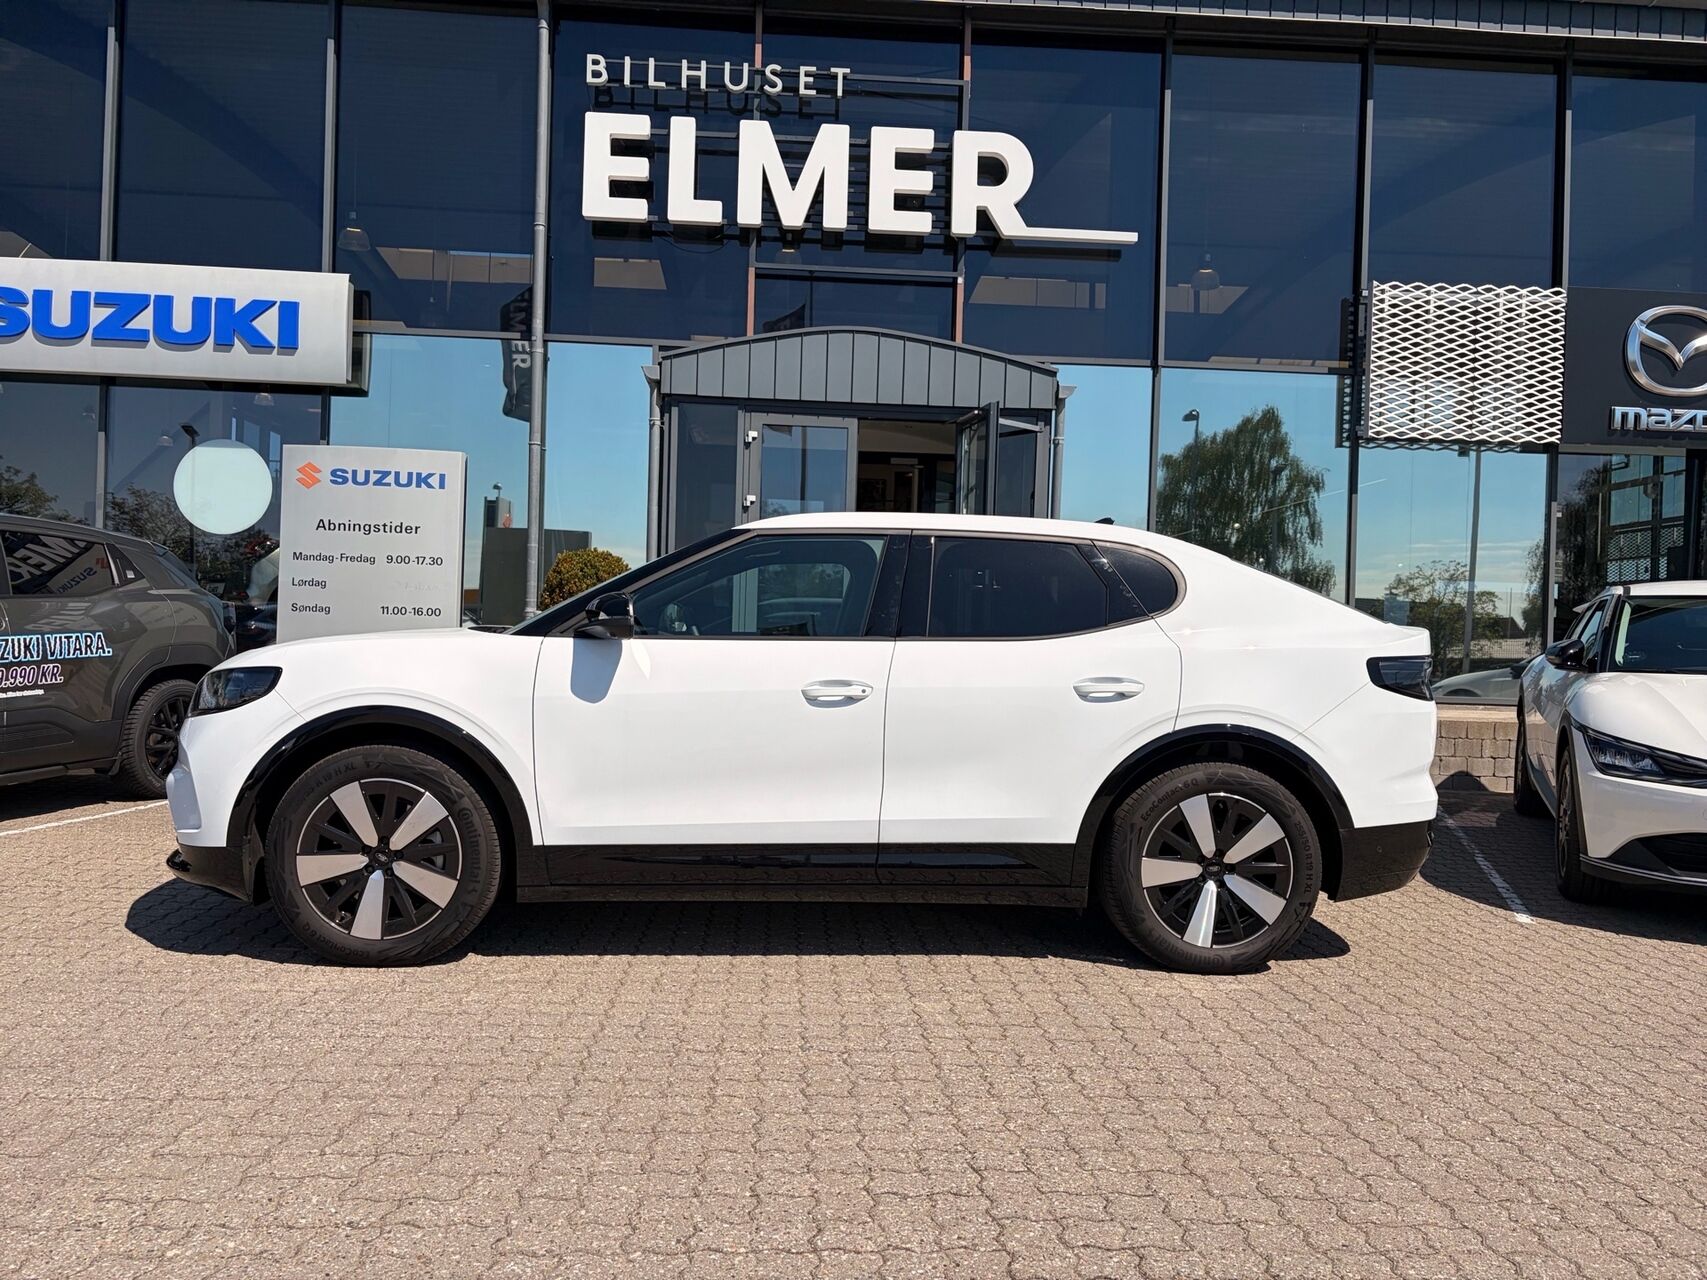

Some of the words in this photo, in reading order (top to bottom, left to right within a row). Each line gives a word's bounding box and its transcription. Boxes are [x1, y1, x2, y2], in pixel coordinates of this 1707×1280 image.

[585, 53, 853, 98] BILHUSET
[581, 111, 1138, 244] ELMER
[329, 468, 446, 490] SUZUKI
[315, 518, 421, 535] Abningstider
[291, 577, 327, 589] Lørdag
[291, 602, 331, 615] Søndag
[44, 632, 113, 660] VITARA.
[38, 663, 64, 685] KR.
